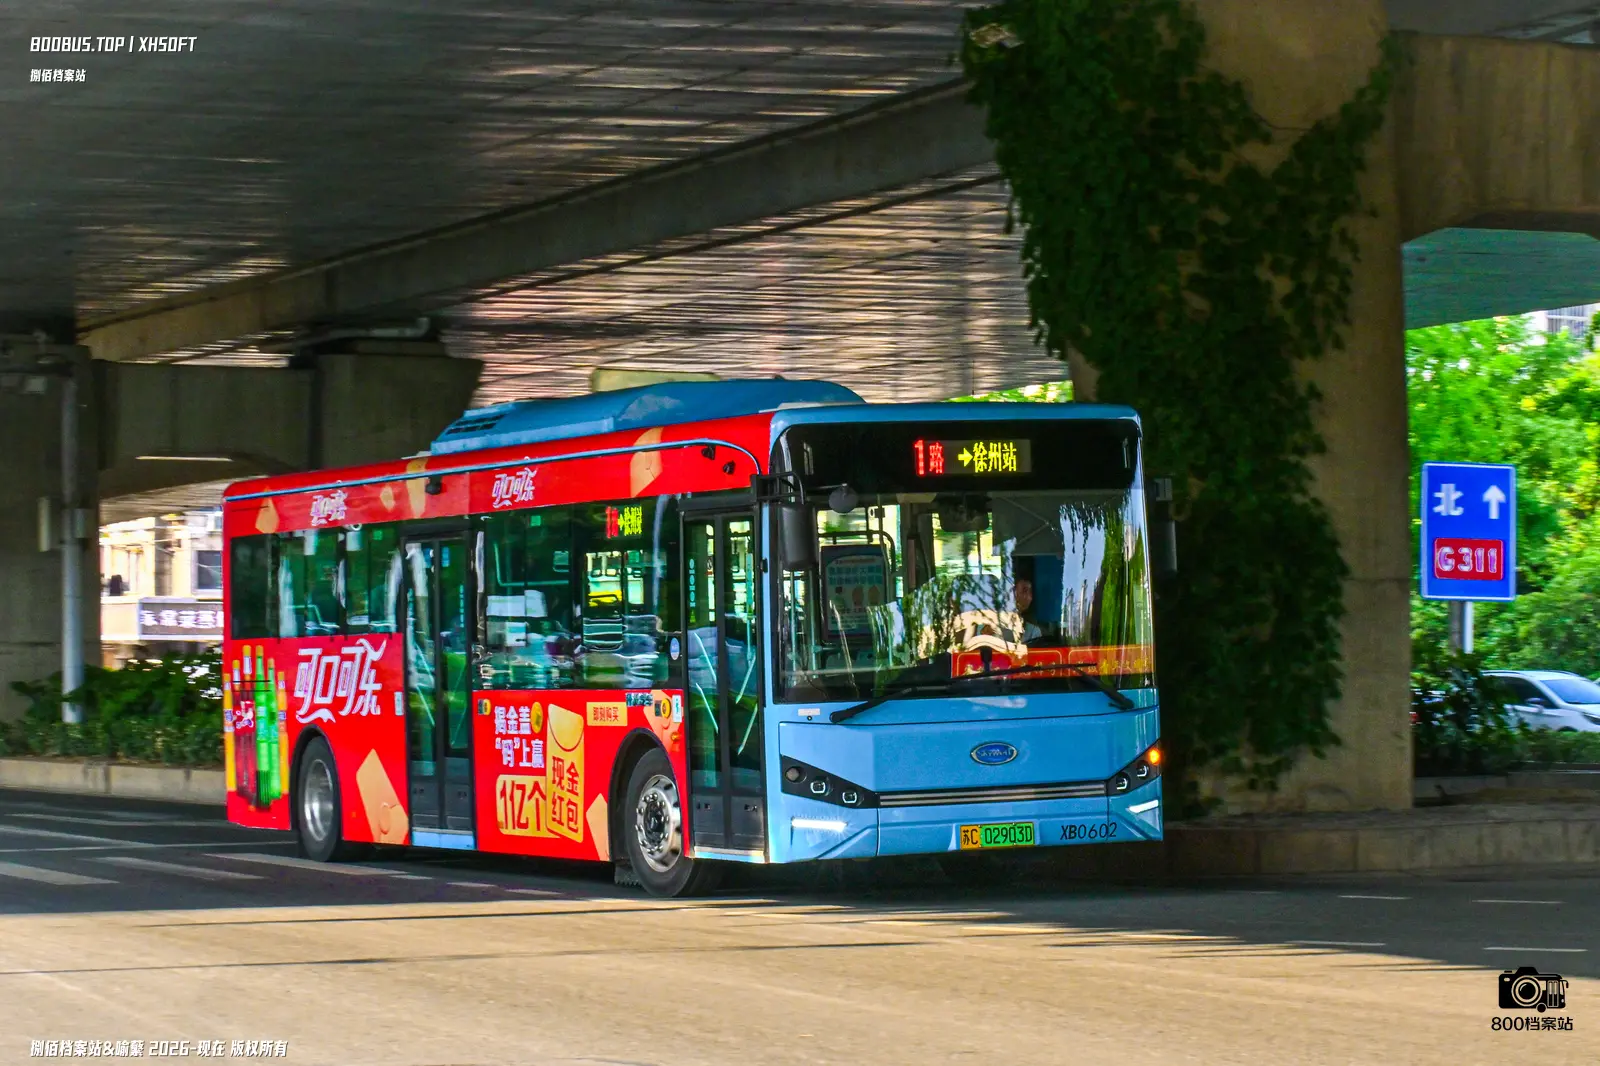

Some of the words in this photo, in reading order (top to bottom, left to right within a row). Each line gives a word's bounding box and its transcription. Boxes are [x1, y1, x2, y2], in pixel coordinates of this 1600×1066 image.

[973, 441, 1017, 473] 徐州站
[492, 467, 538, 508] 可口可乐
[1433, 483, 1464, 516] 北
[1437, 546, 1498, 573] G311
[293, 638, 387, 724] 可口可乐
[551, 756, 580, 797] 现金
[500, 779, 547, 832] 1亿个
[551, 791, 579, 832] 红包
[1060, 822, 1118, 840] XB0602
